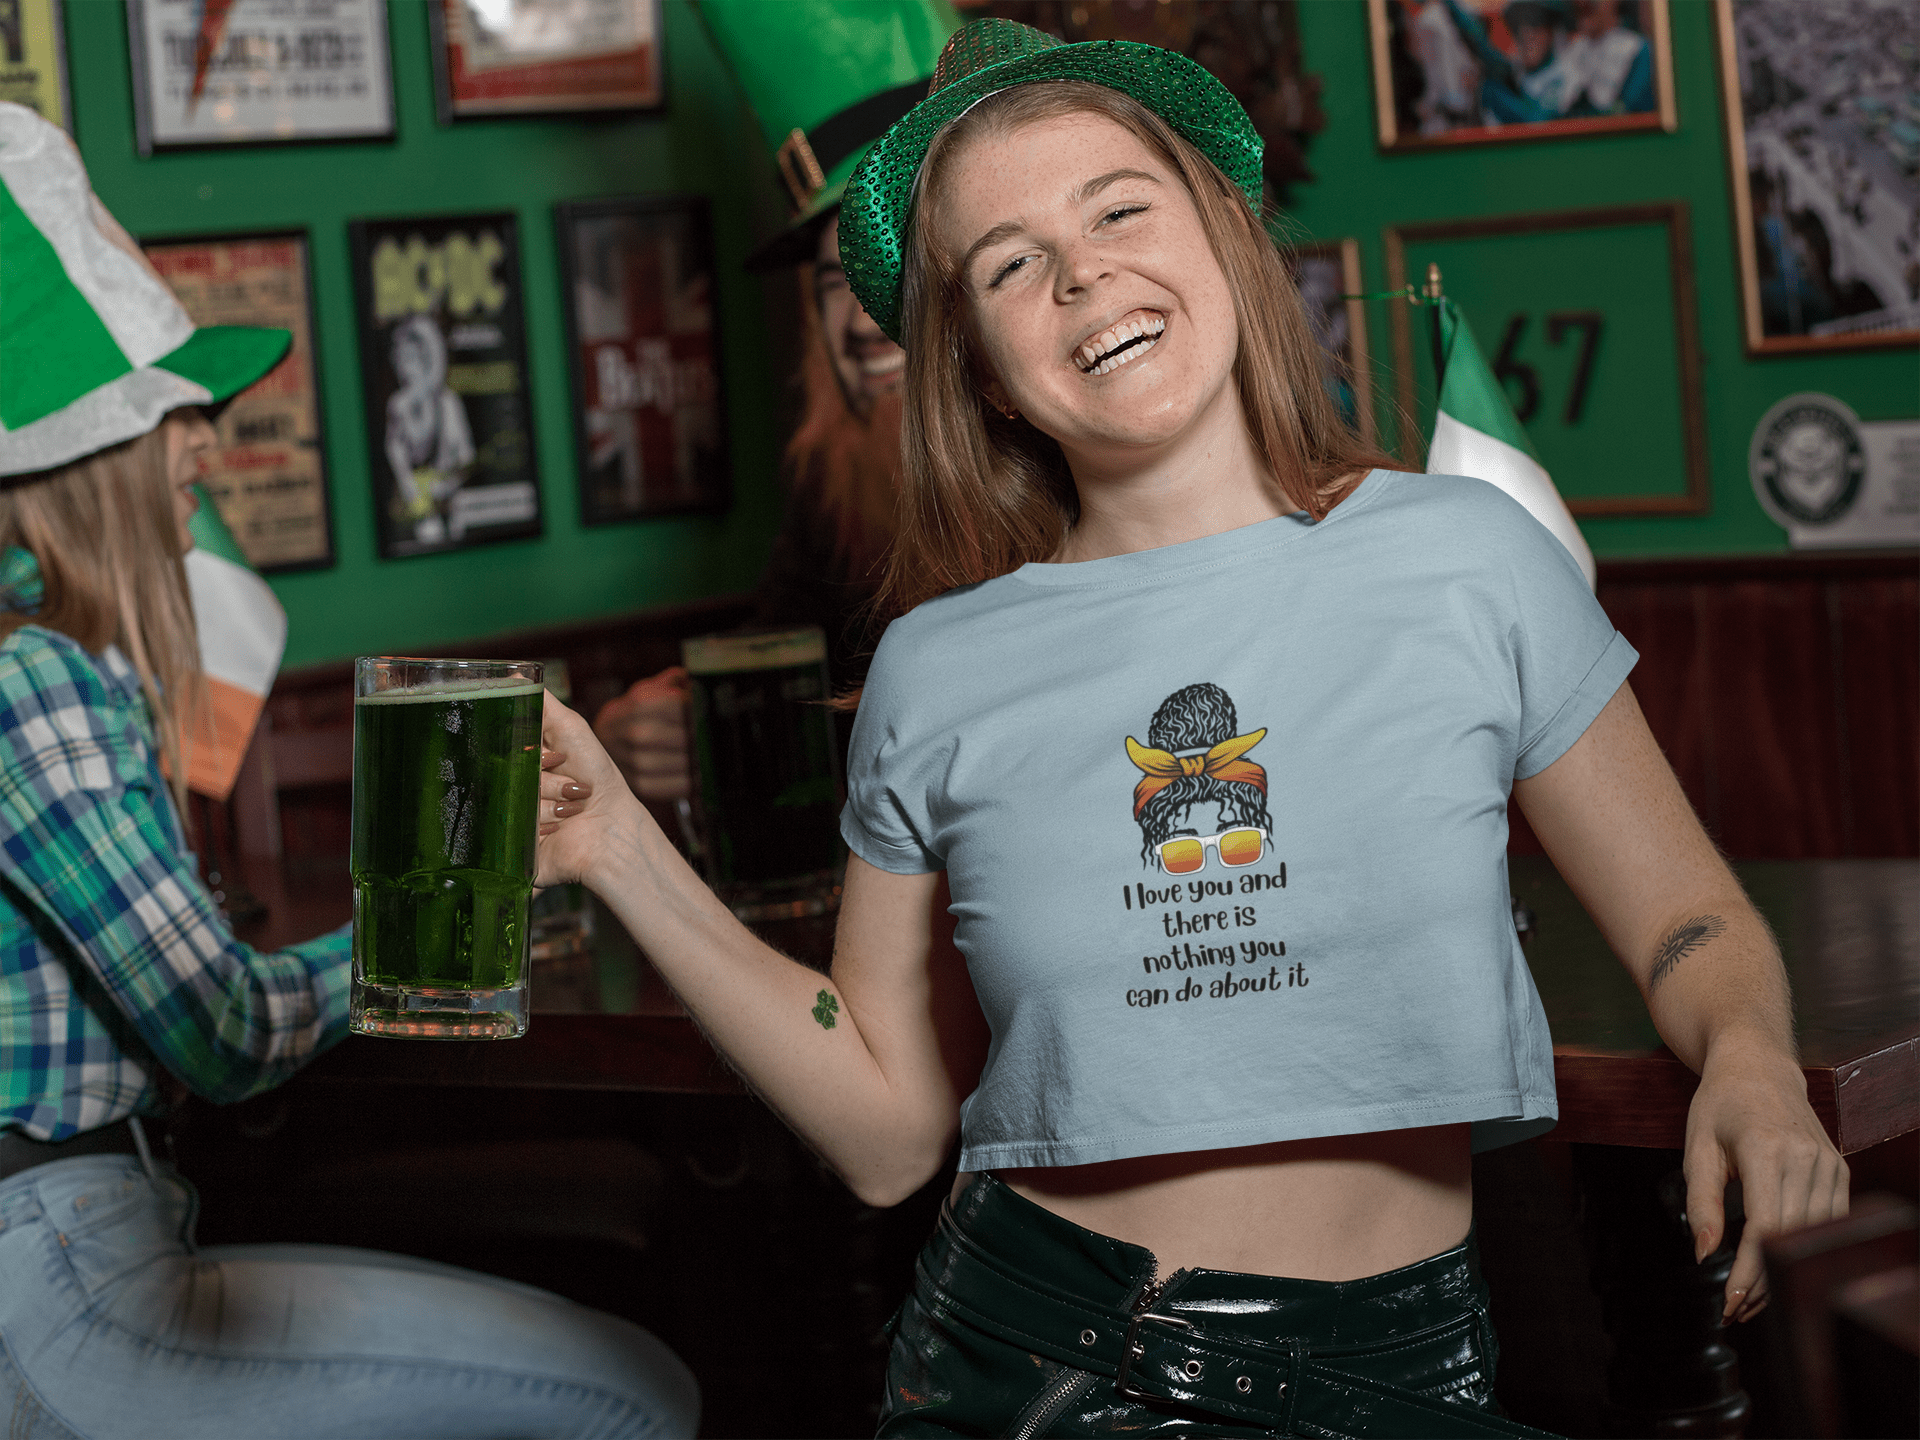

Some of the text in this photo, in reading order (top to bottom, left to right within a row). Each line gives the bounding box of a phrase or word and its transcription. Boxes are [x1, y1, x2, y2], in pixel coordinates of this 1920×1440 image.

[1494, 312, 1603, 424] 67
[1123, 861, 1287, 910] I love you and
[1162, 906, 1257, 937] there is
[1143, 940, 1286, 974] nothing you
[1126, 962, 1309, 1008] can do about it
